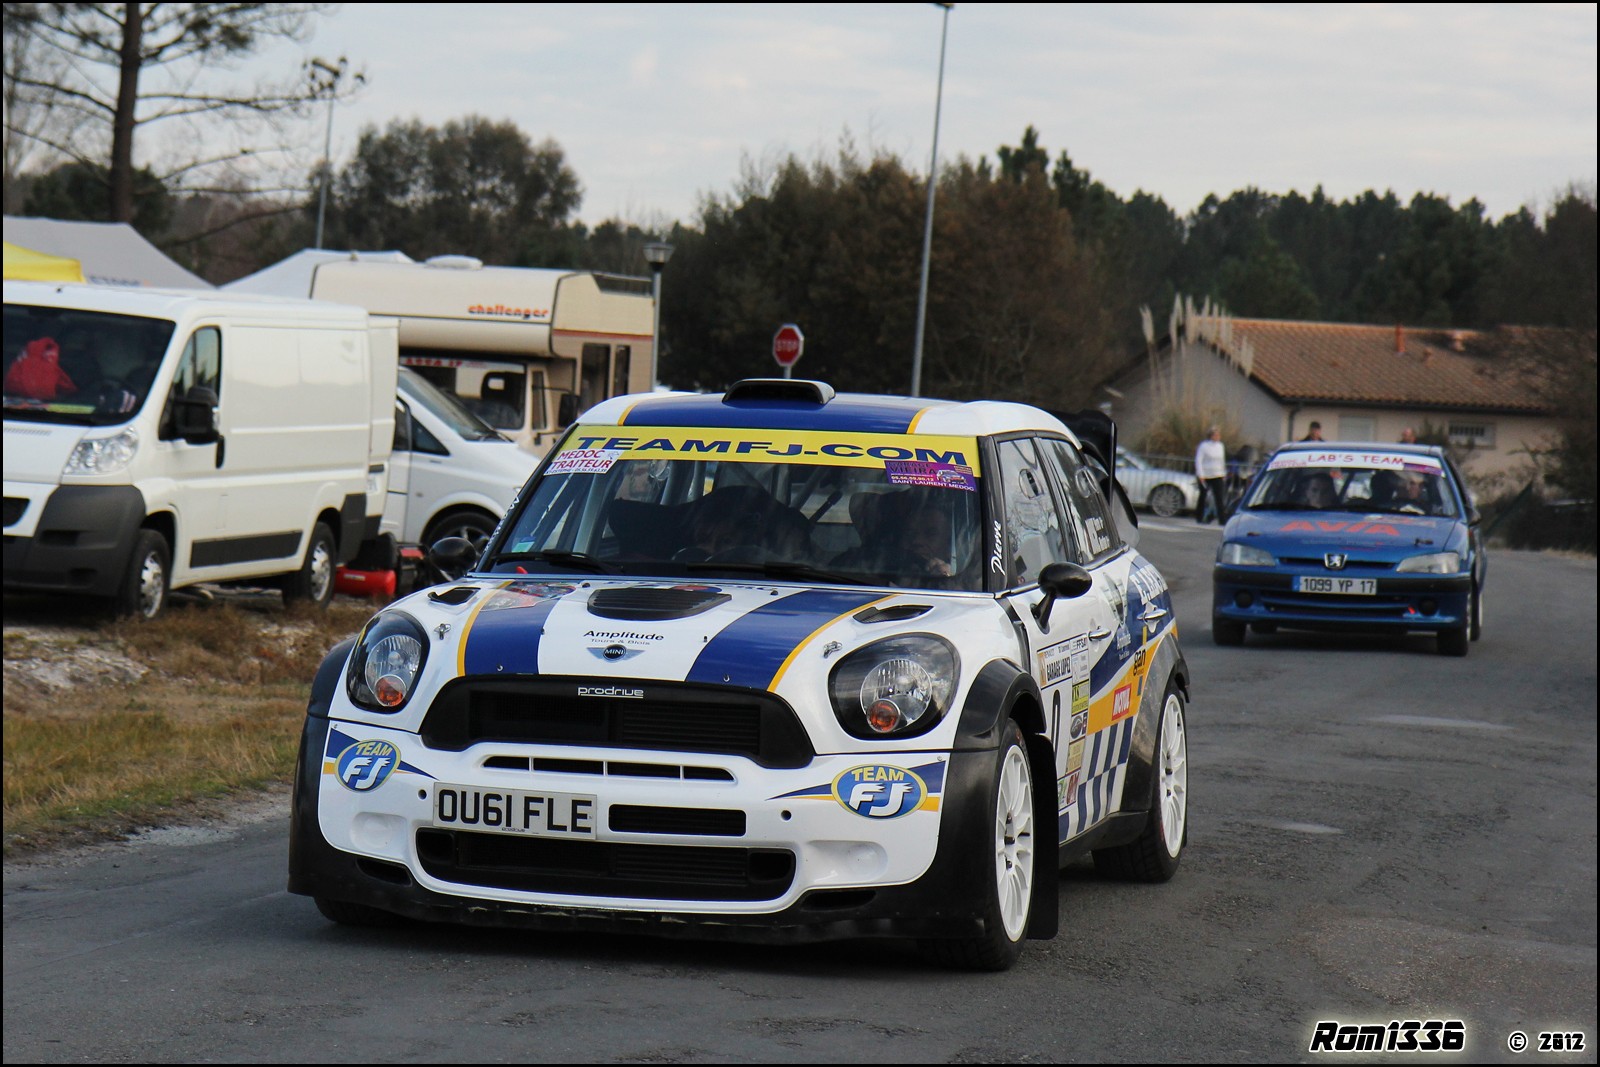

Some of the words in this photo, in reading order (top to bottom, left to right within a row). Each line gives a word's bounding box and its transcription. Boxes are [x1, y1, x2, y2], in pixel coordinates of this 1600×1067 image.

[467, 304, 550, 320] challenger
[776, 340, 798, 352] STOP
[557, 449, 606, 460] MEDOC
[1307, 454, 1354, 463] LAB'S
[1362, 455, 1405, 465] TEAM
[550, 459, 613, 470] TRAITEUR
[914, 480, 948, 488] LAURENT
[948, 483, 975, 492] MEDOC
[1279, 520, 1401, 537] AVIA
[991, 520, 1005, 576] Pierre
[1303, 578, 1333, 593] 1099
[1338, 580, 1354, 593] YP
[1359, 580, 1375, 594] 17
[583, 630, 665, 642] Amplitude
[603, 648, 625, 656] MINI
[1133, 649, 1147, 677] gan
[577, 686, 644, 698] prodrive
[1113, 687, 1131, 717] MOTUL
[356, 741, 394, 757] TEAM
[342, 757, 390, 790] FJ
[851, 767, 905, 782] TEAM
[848, 783, 914, 817] FJ
[438, 788, 513, 828] OU61
[523, 796, 593, 834] FLE
